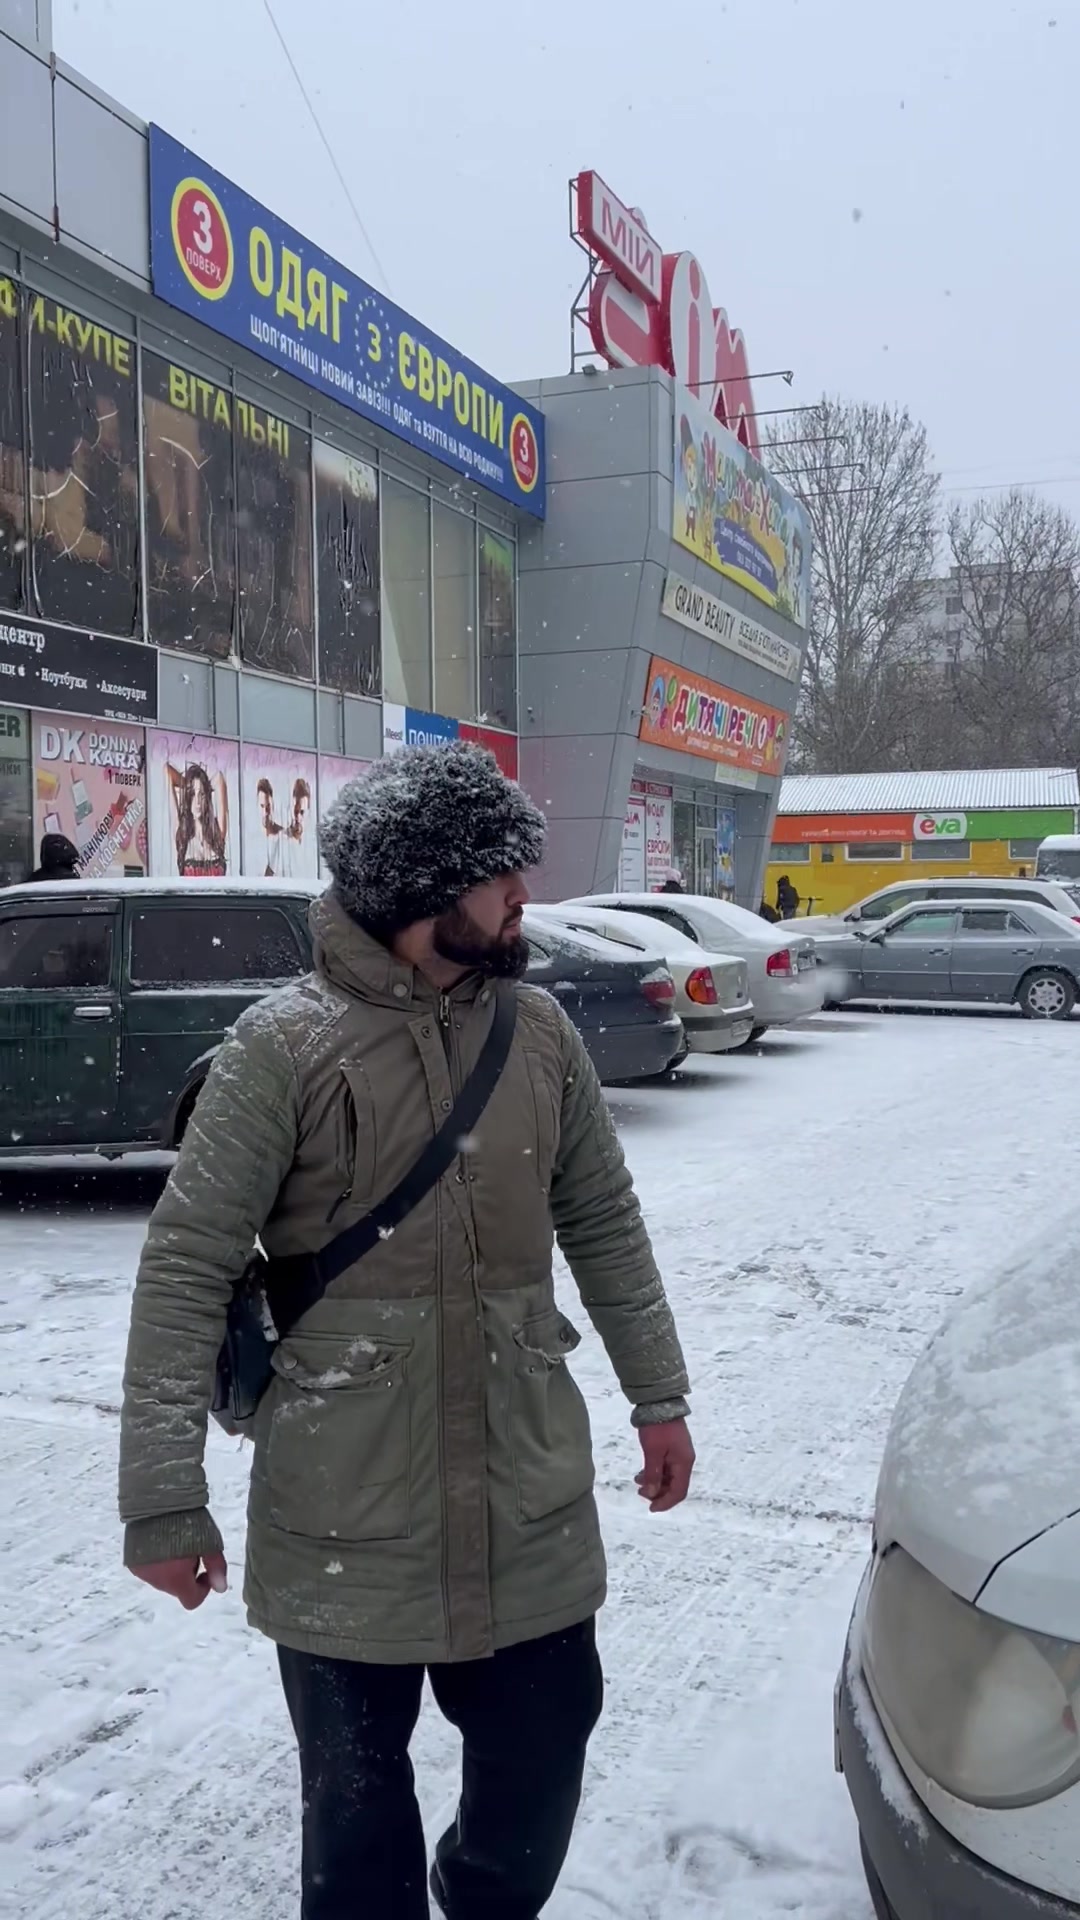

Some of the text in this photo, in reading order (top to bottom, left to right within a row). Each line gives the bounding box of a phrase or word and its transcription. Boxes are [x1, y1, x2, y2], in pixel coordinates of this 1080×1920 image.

[192, 199, 214, 254] 3
[602, 197, 655, 287] МІЙ
[185, 246, 222, 282] ПОВЕРХ
[250, 226, 348, 343] ОДЯГ
[398, 331, 504, 449] ЄВРОПИ
[321, 358, 354, 395] НОВИЙ
[356, 380, 391, 416] ЗАВІЗ!!!
[393, 402, 412, 427] ОДЯГ
[519, 427, 529, 463] 3
[675, 584, 736, 640] GRAND BEAUTY
[41, 667, 88, 690] Ноутбуки
[101, 679, 147, 702] Аксесуари
[40, 725, 85, 763] DK
[89, 732, 139, 754] DONNA
[672, 684, 729, 740] ДИТЯЧІ
[727, 705, 759, 749] РЕЧІ
[107, 769, 141, 787] 1 ПОВЕРХ
[79, 810, 115, 871] МАНІКЮРУ
[98, 799, 144, 870] КОСМЕТИКА
